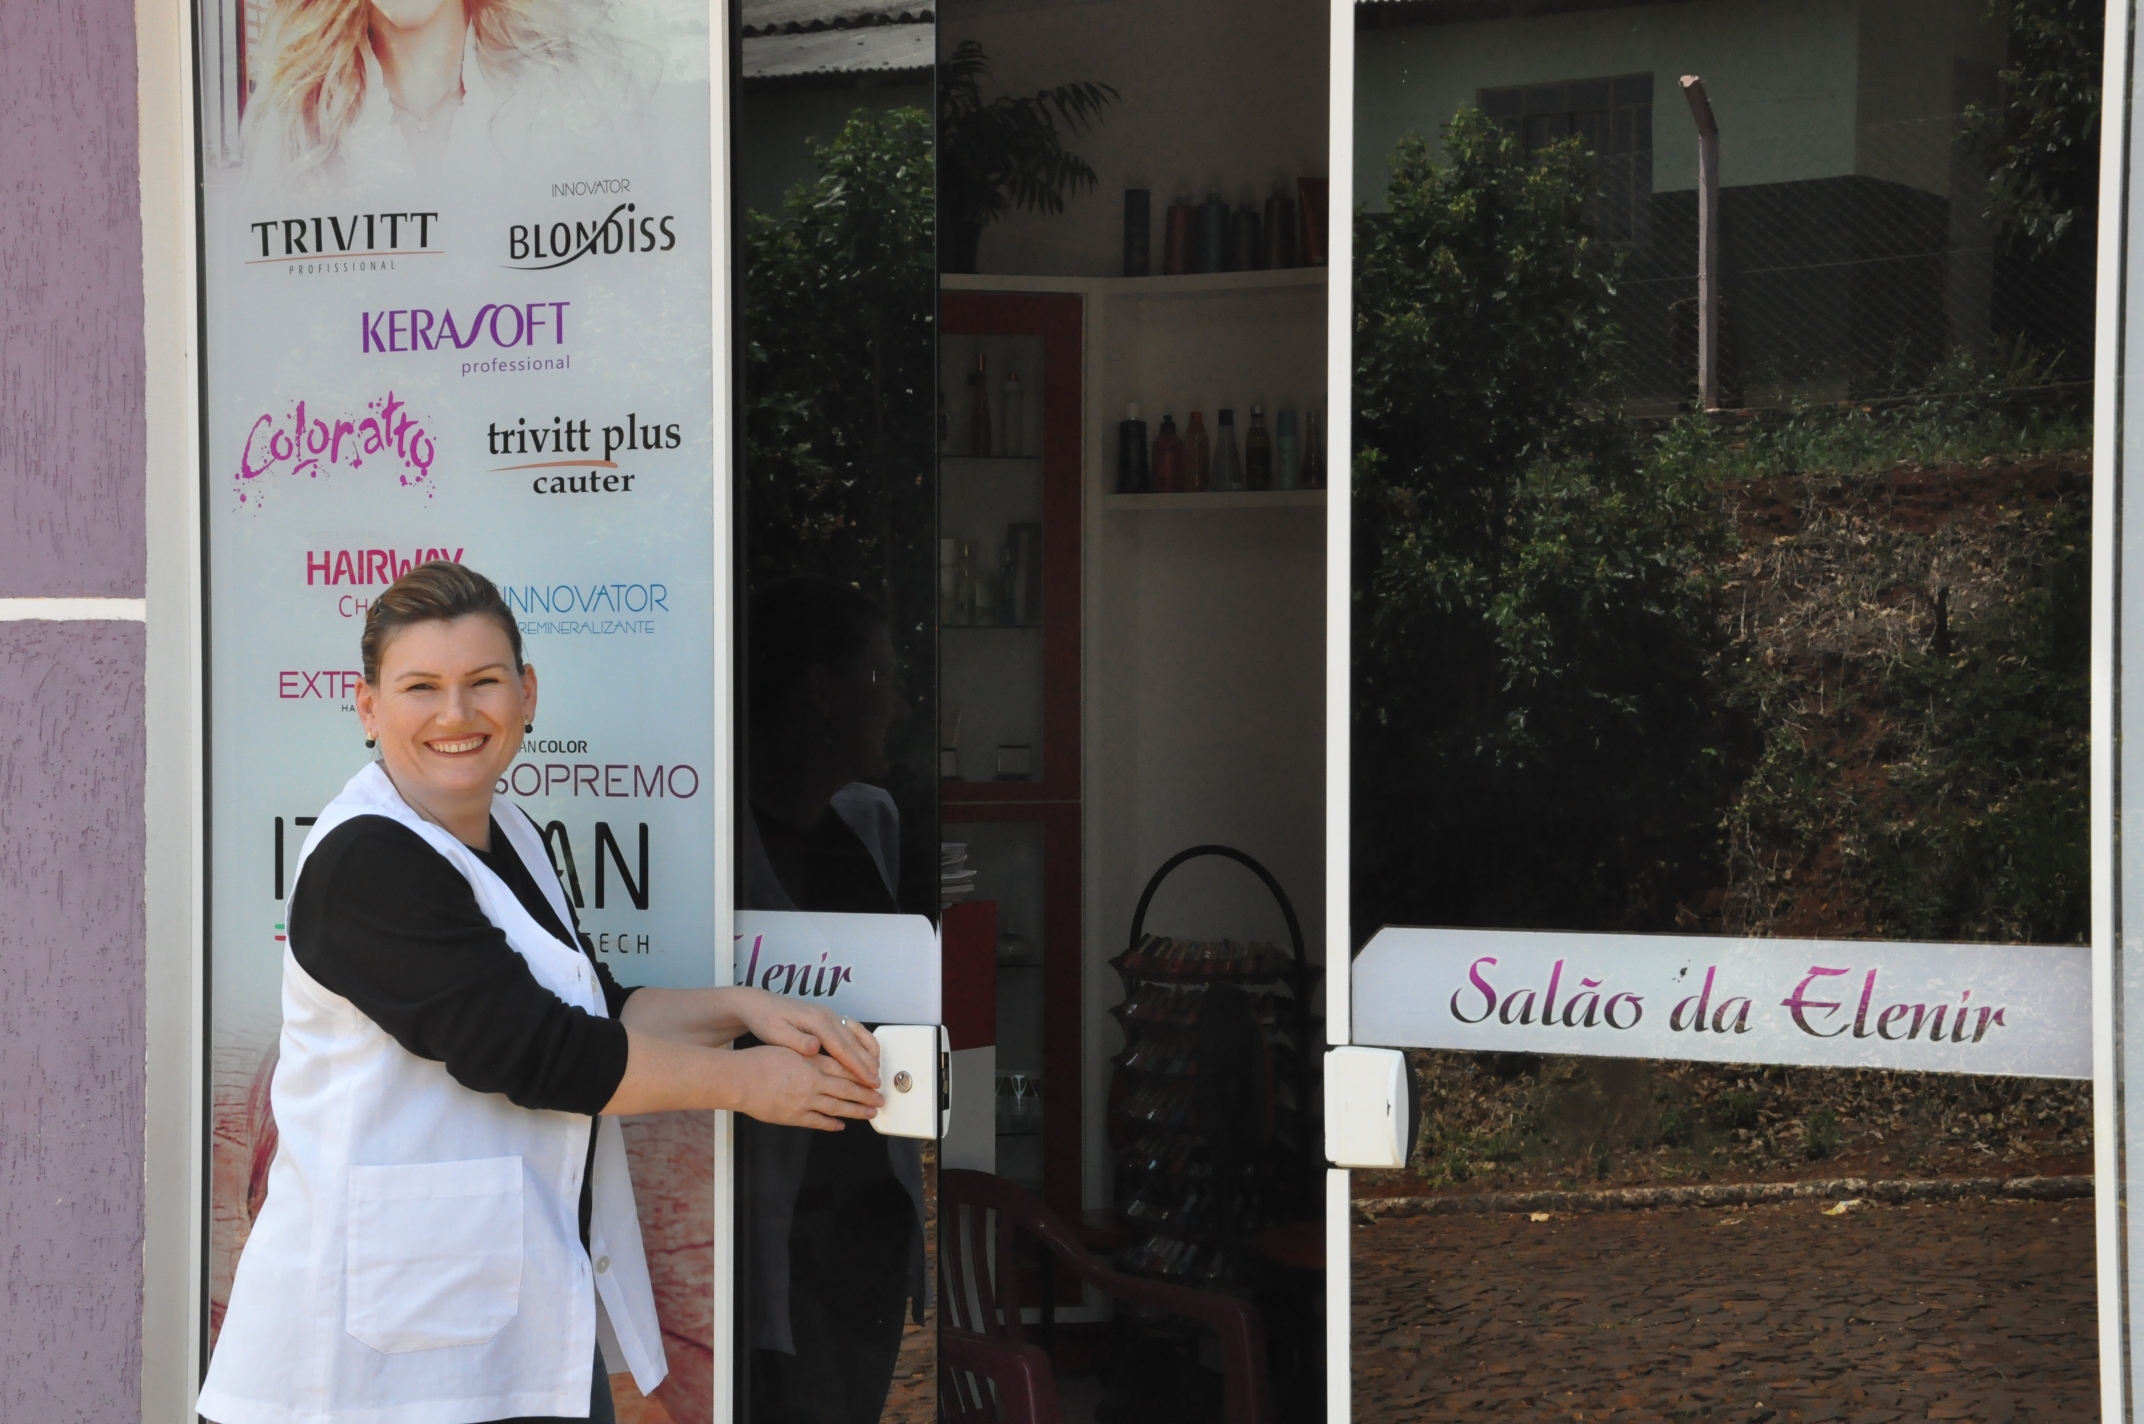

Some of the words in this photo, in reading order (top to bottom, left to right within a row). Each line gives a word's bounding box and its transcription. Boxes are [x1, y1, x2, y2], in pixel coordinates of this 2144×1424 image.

[552, 179, 630, 197] INNOVATOR
[251, 212, 438, 257] TRIVITT
[289, 260, 395, 275] PROFISSIONAL
[362, 302, 571, 353] KERASOFT
[461, 355, 570, 377] professional
[488, 416, 591, 455] trivitt
[603, 413, 681, 462] plus
[533, 471, 635, 494] cauter
[503, 584, 669, 613] INNOVATOR
[518, 621, 655, 634] REMINERALIZANTE
[581, 932, 648, 954] ECH
[733, 934, 852, 997] lenir
[1450, 957, 1645, 1030] Salão
[1669, 966, 1753, 1034] da
[1780, 966, 2006, 1044] Elenir
